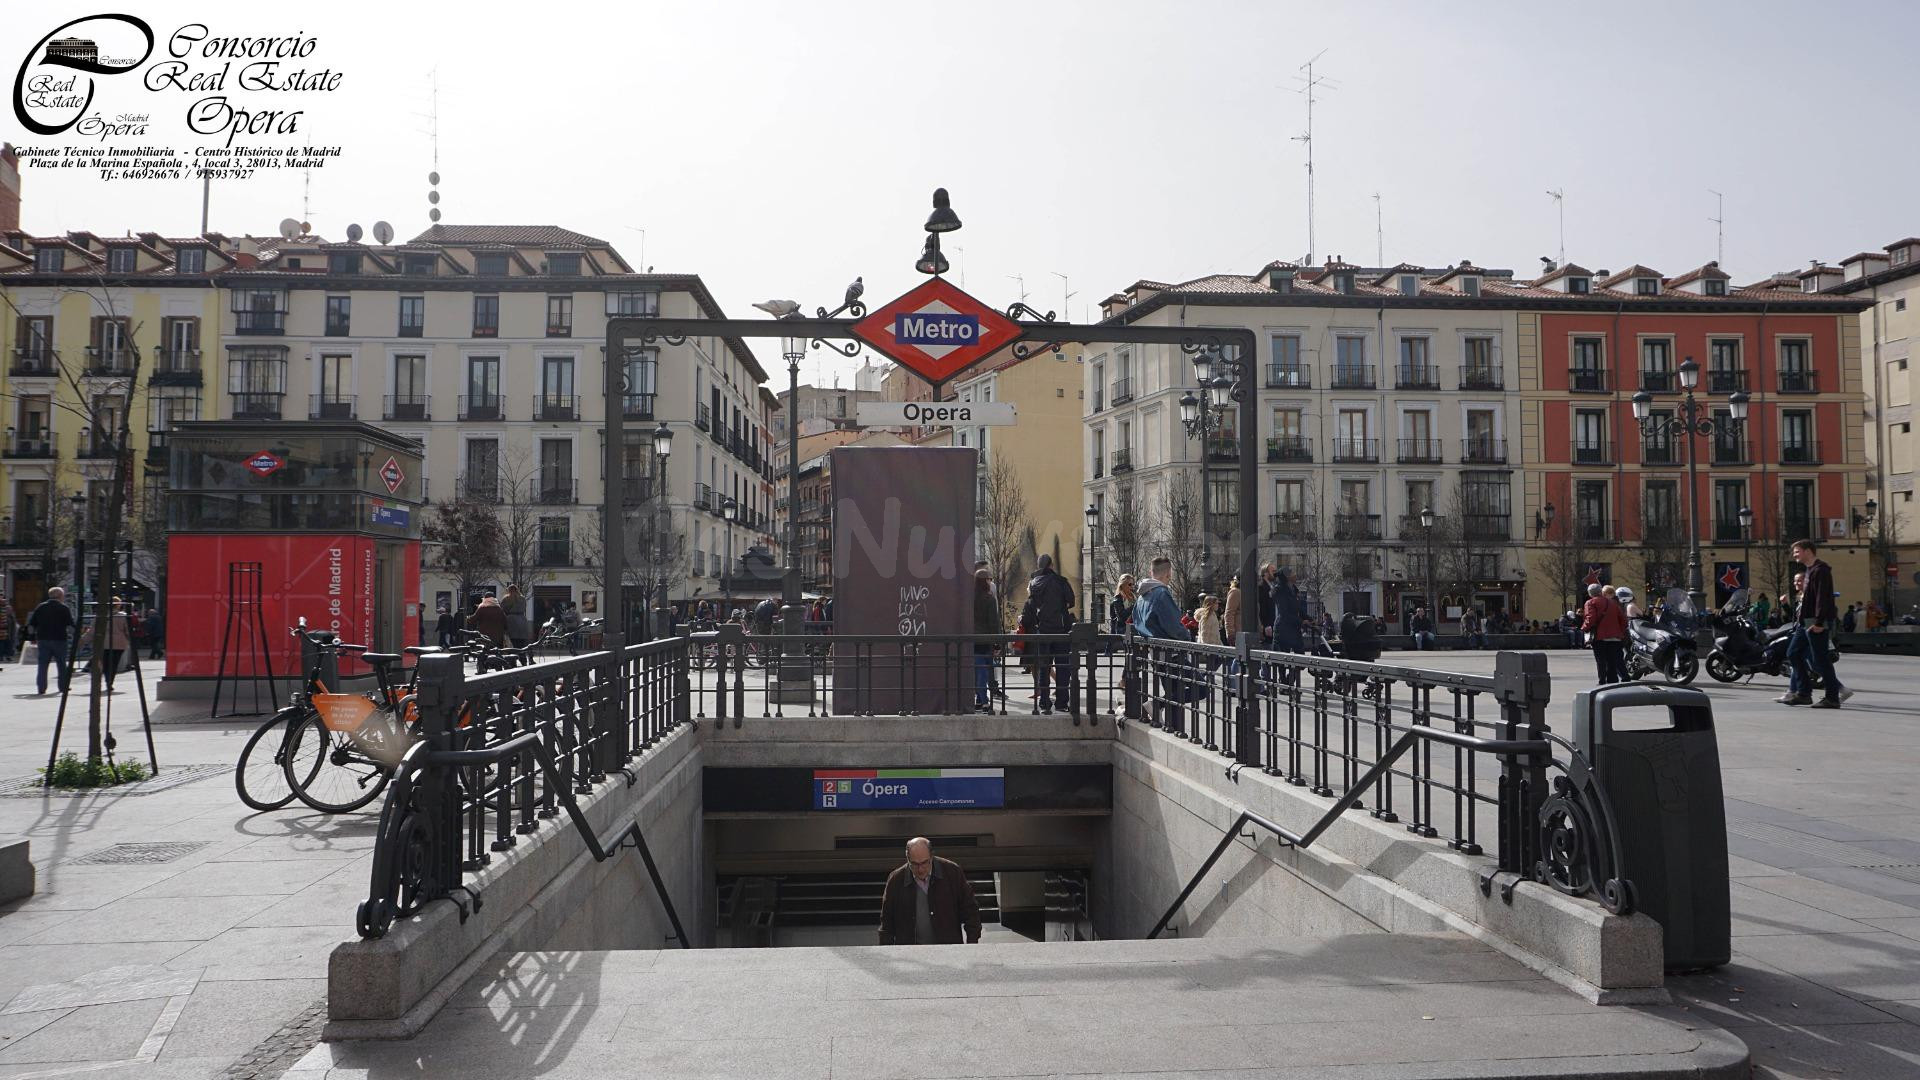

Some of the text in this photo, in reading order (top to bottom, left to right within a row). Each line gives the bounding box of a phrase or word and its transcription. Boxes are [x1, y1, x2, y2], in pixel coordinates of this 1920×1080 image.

[903, 318, 973, 339] Metro
[903, 403, 971, 424] Opera
[329, 548, 341, 595] Madrid
[329, 599, 341, 616] de
[364, 599, 370, 615] de
[825, 779, 908, 797] 2 5 Ópera
[825, 796, 835, 806] R
